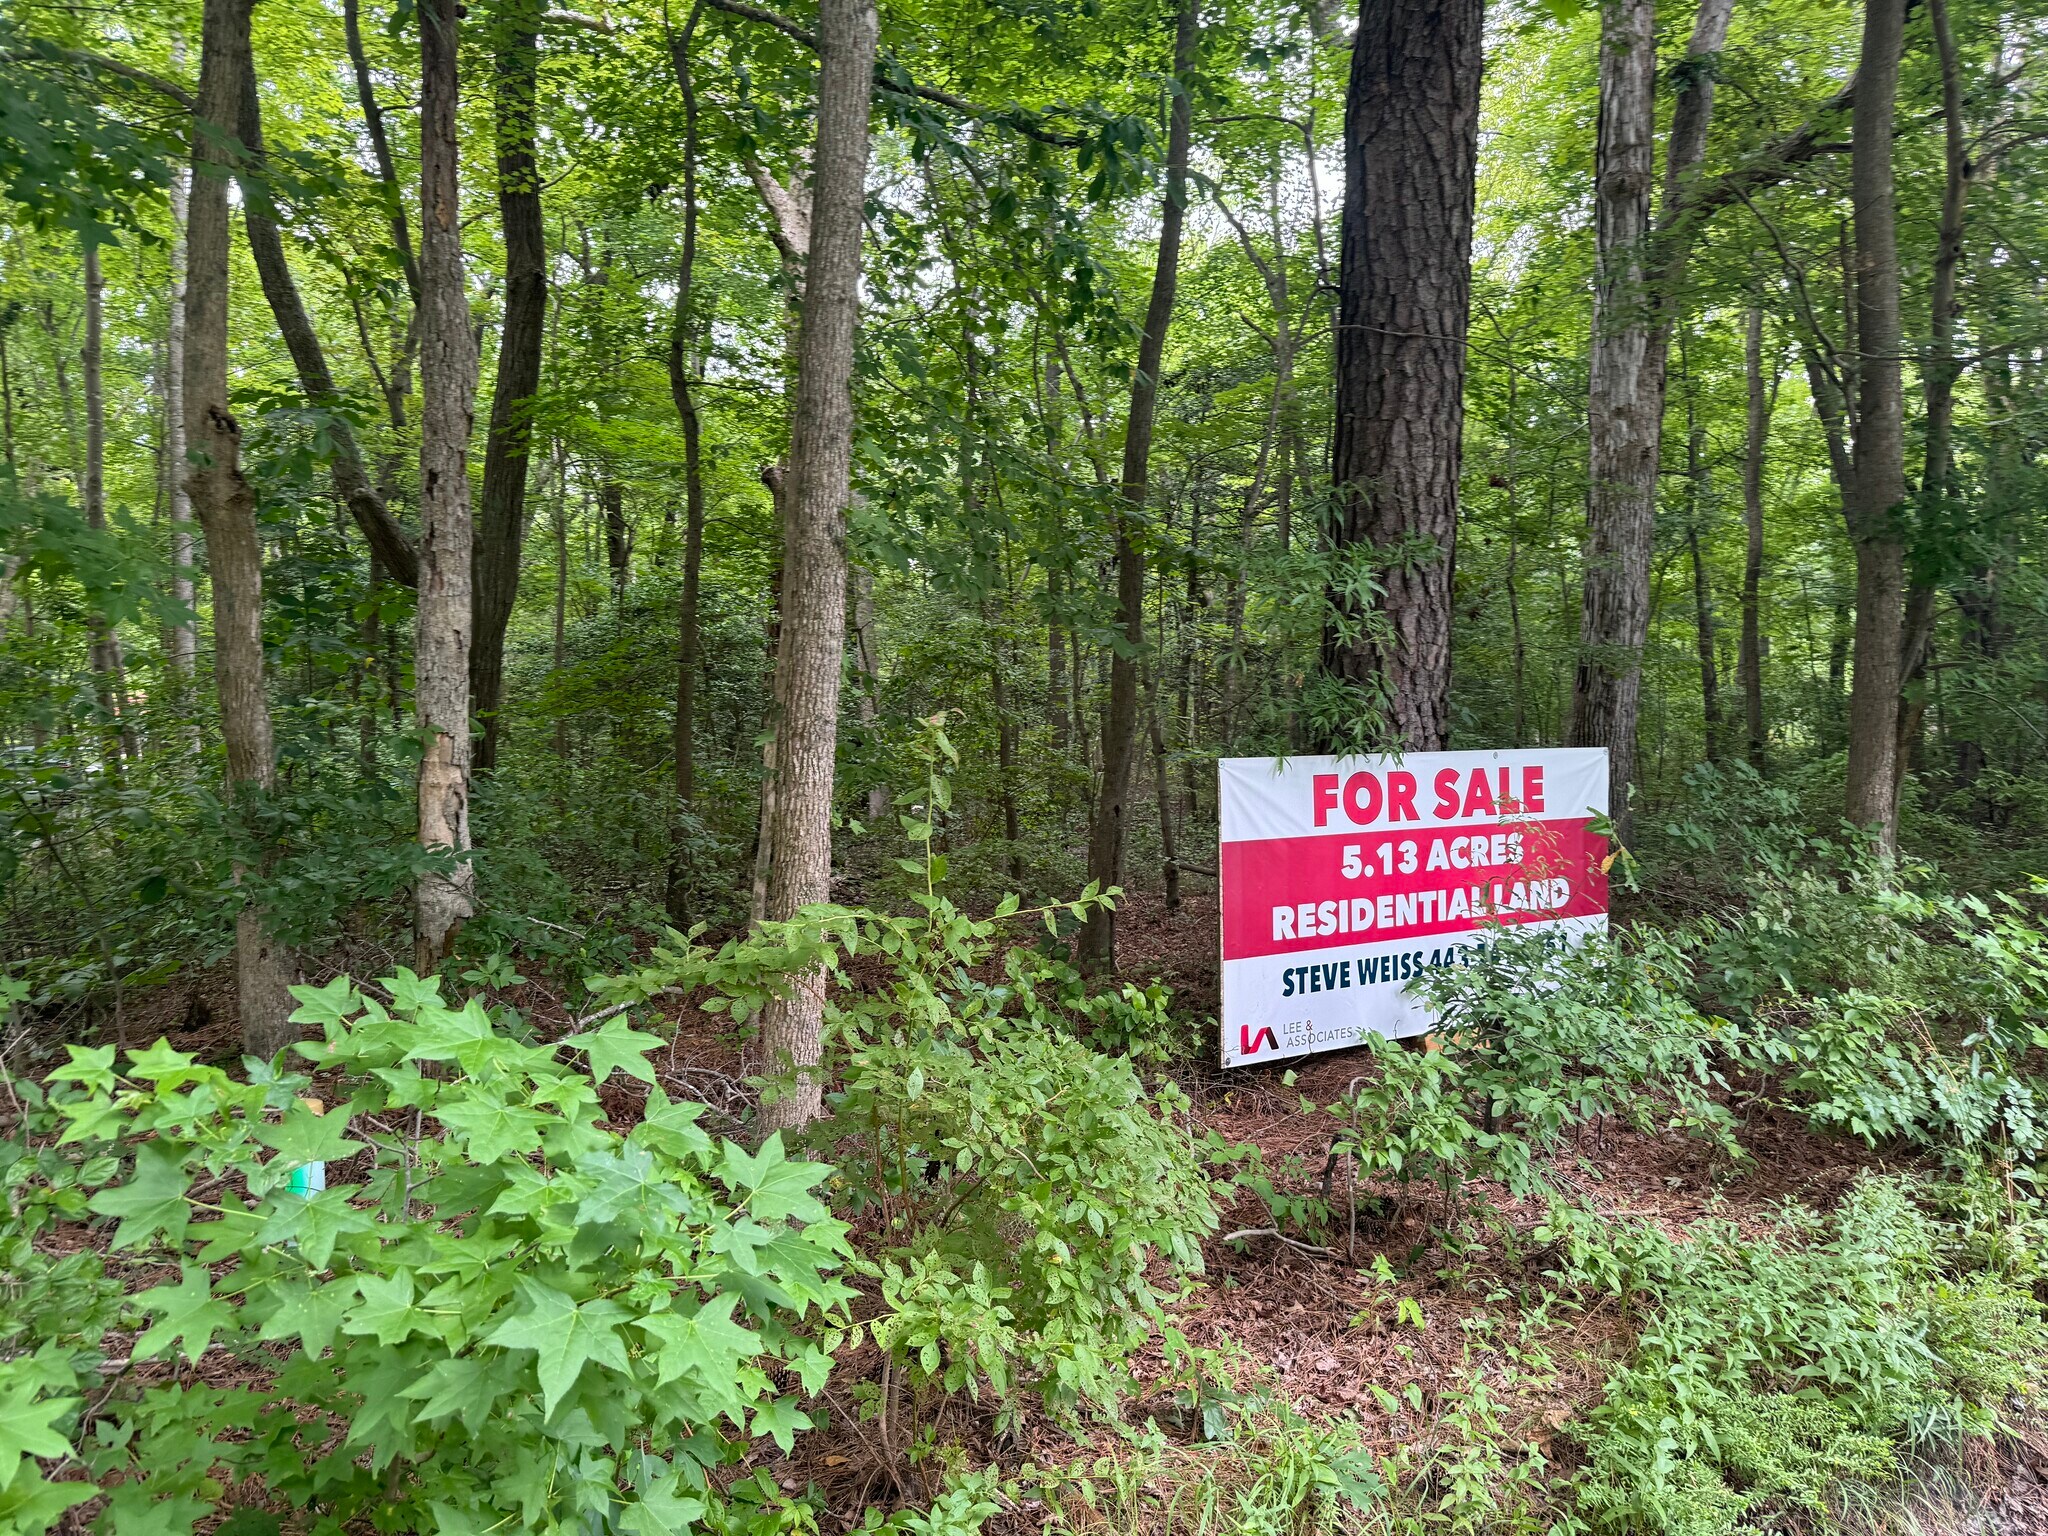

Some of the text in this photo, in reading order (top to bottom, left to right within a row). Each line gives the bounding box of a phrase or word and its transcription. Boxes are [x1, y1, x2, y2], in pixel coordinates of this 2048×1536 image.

[1312, 765, 1545, 828] FOR SALE
[1341, 832, 1524, 880] 5.13 ACRES
[1272, 877, 1570, 941] RESIDENTIAL LAND
[1282, 962, 1350, 997] STEVE
[1357, 951, 1424, 986] WEISS
[1283, 1019, 1313, 1035] LEE &
[1286, 1026, 1353, 1049] ASSOCIATES
